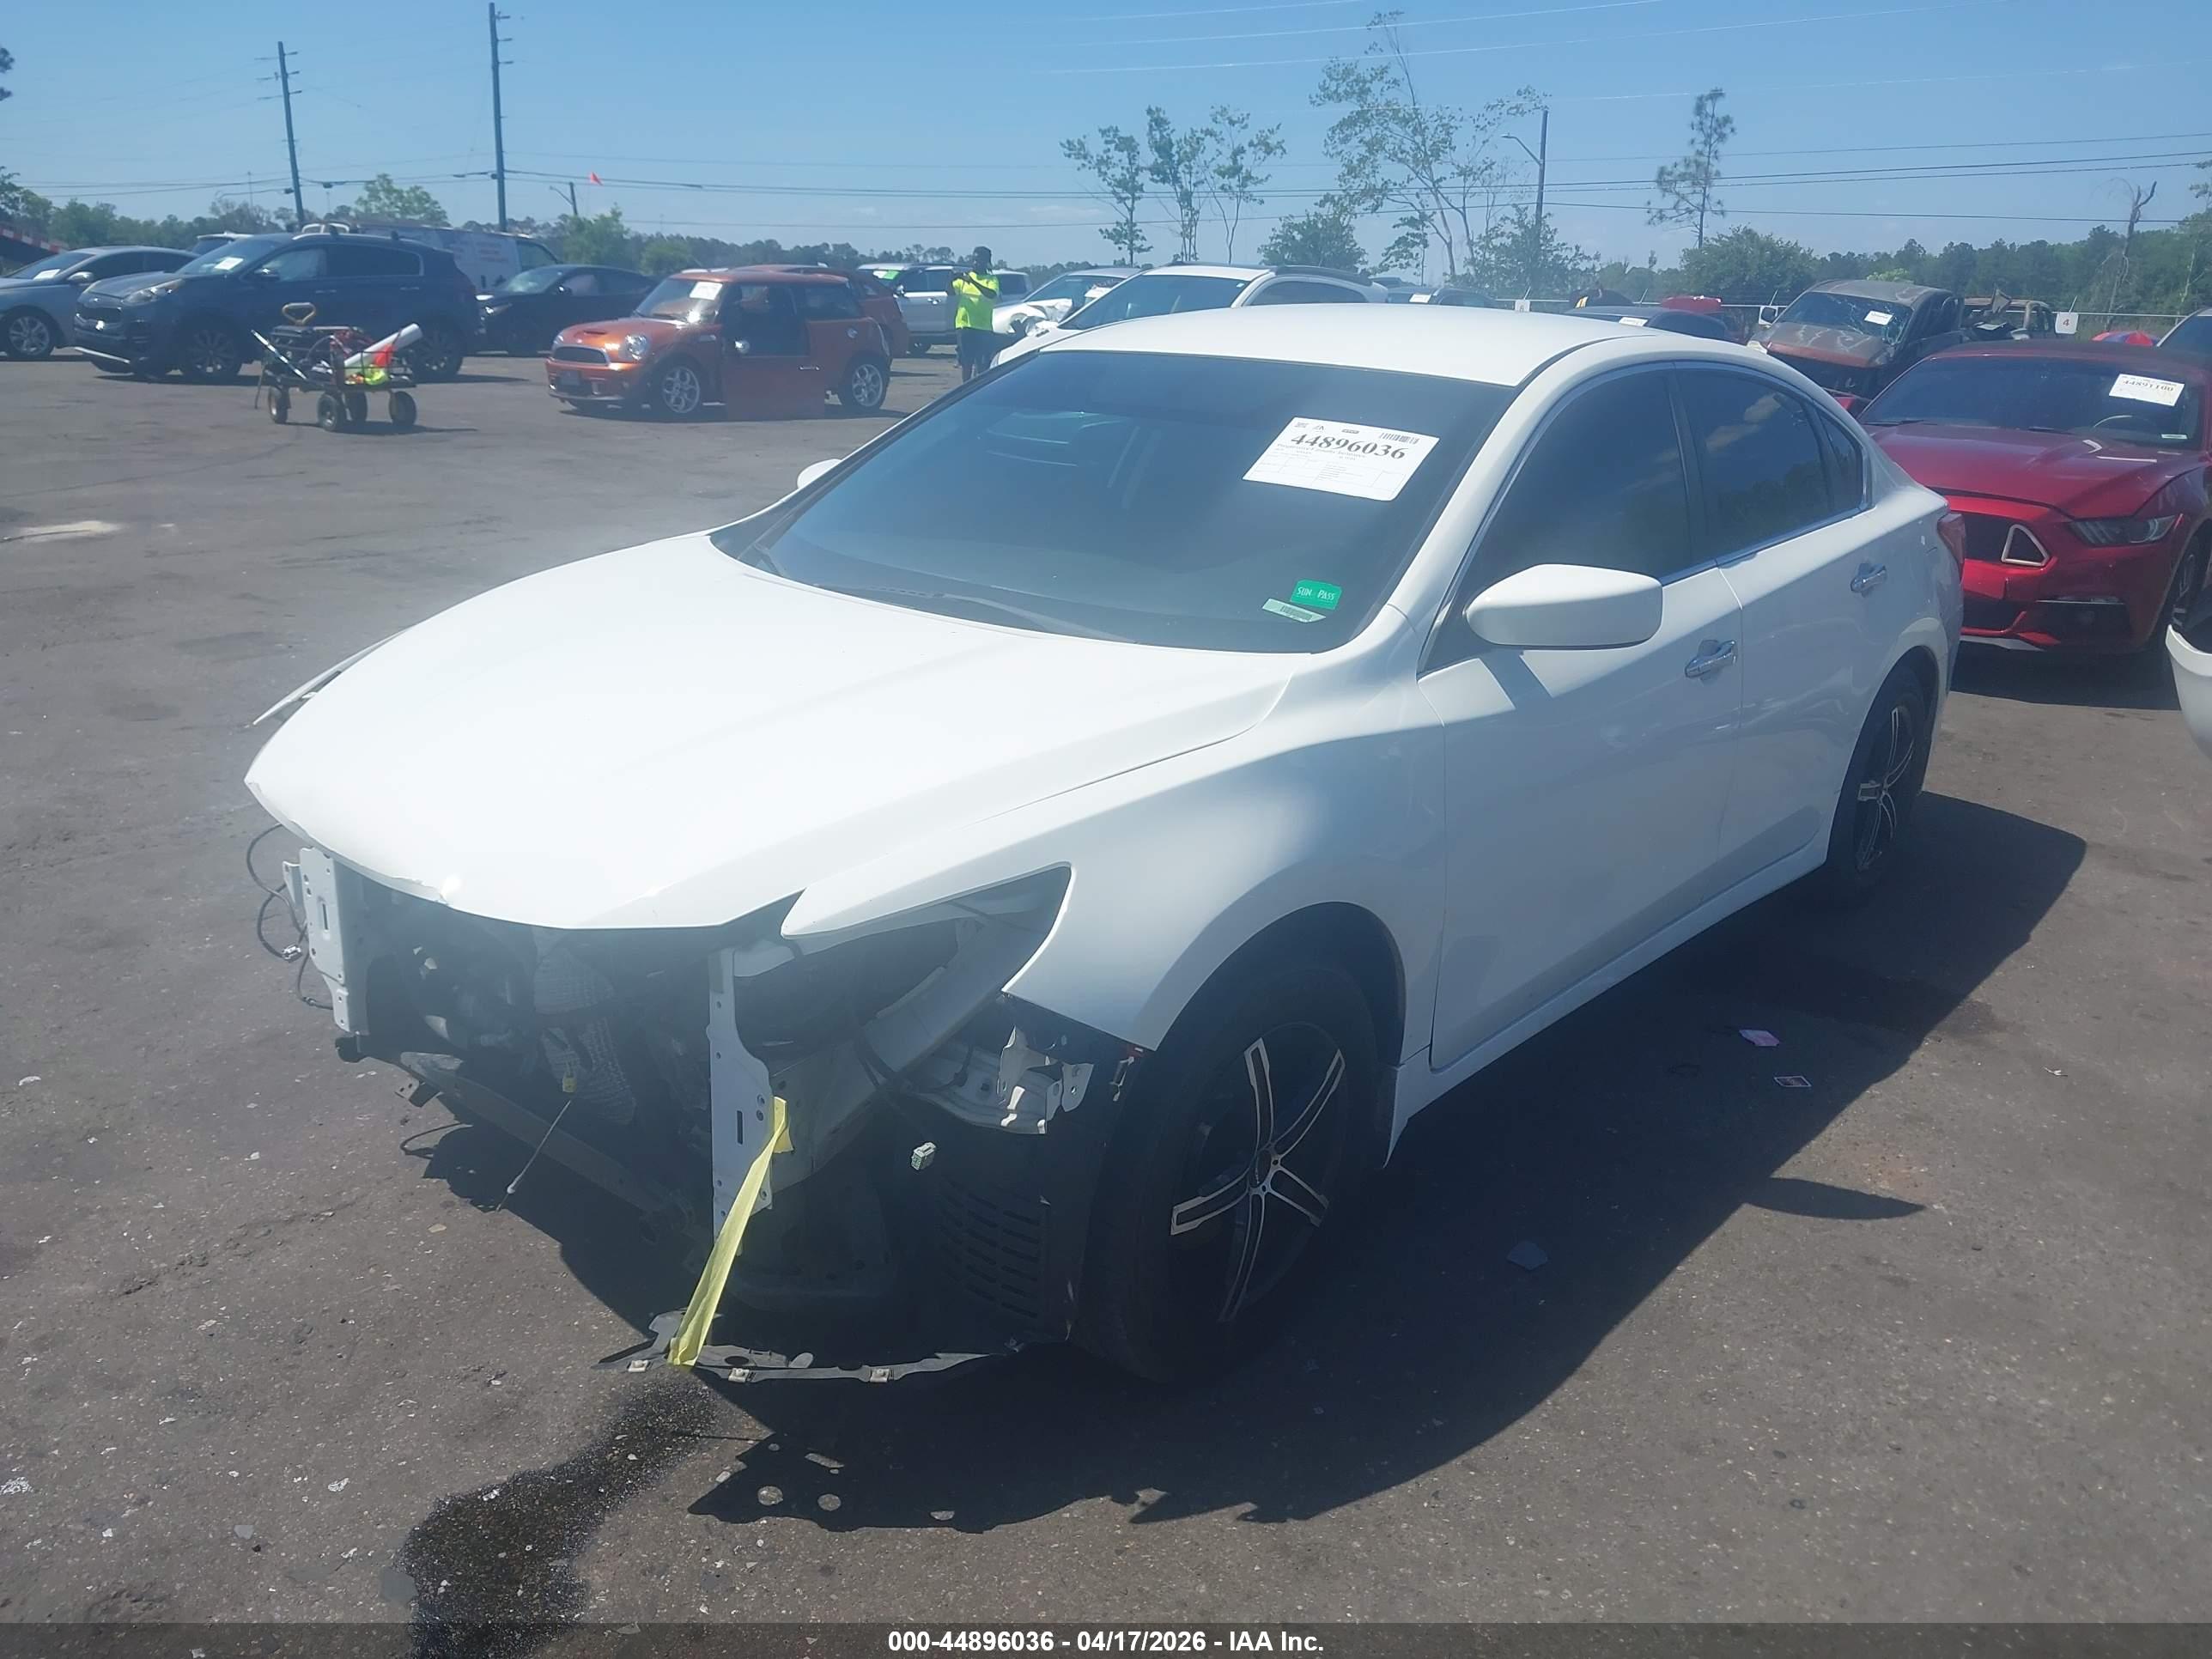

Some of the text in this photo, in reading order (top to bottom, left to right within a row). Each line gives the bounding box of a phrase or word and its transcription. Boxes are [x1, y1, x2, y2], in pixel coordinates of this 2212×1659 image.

[1291, 433, 1409, 460] 44896036
[1297, 586, 1335, 601] SUN PASS
